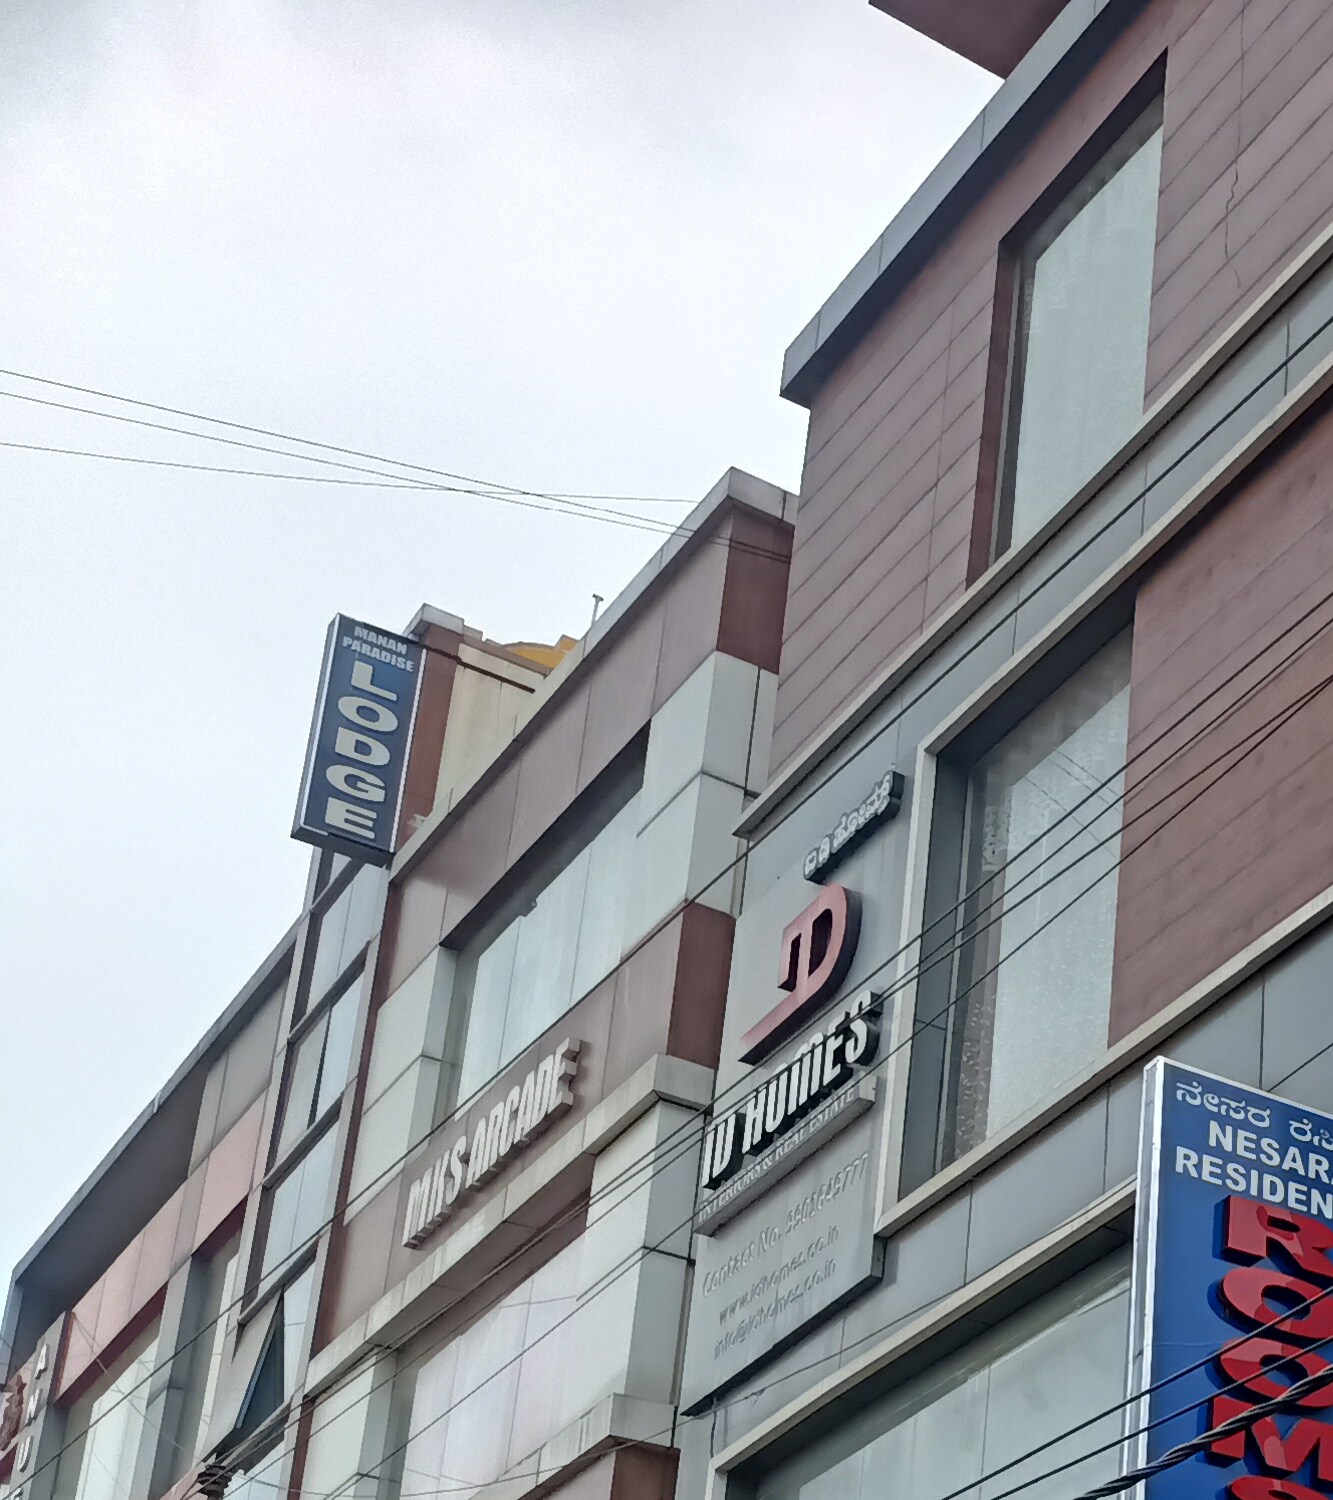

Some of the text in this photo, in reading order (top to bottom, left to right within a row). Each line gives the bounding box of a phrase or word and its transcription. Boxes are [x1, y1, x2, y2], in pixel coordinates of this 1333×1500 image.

[342, 636, 415, 673] PARADISE
[354, 626, 408, 655] MANAN
[325, 660, 399, 840] LODGE
[742, 990, 873, 1155] HOMES
[1176, 1081, 1272, 1128] ನೇಸರ
[402, 1037, 573, 1247] MKS ARCADE
[703, 1243, 755, 1298] Contact
[757, 1225, 783, 1257] No.
